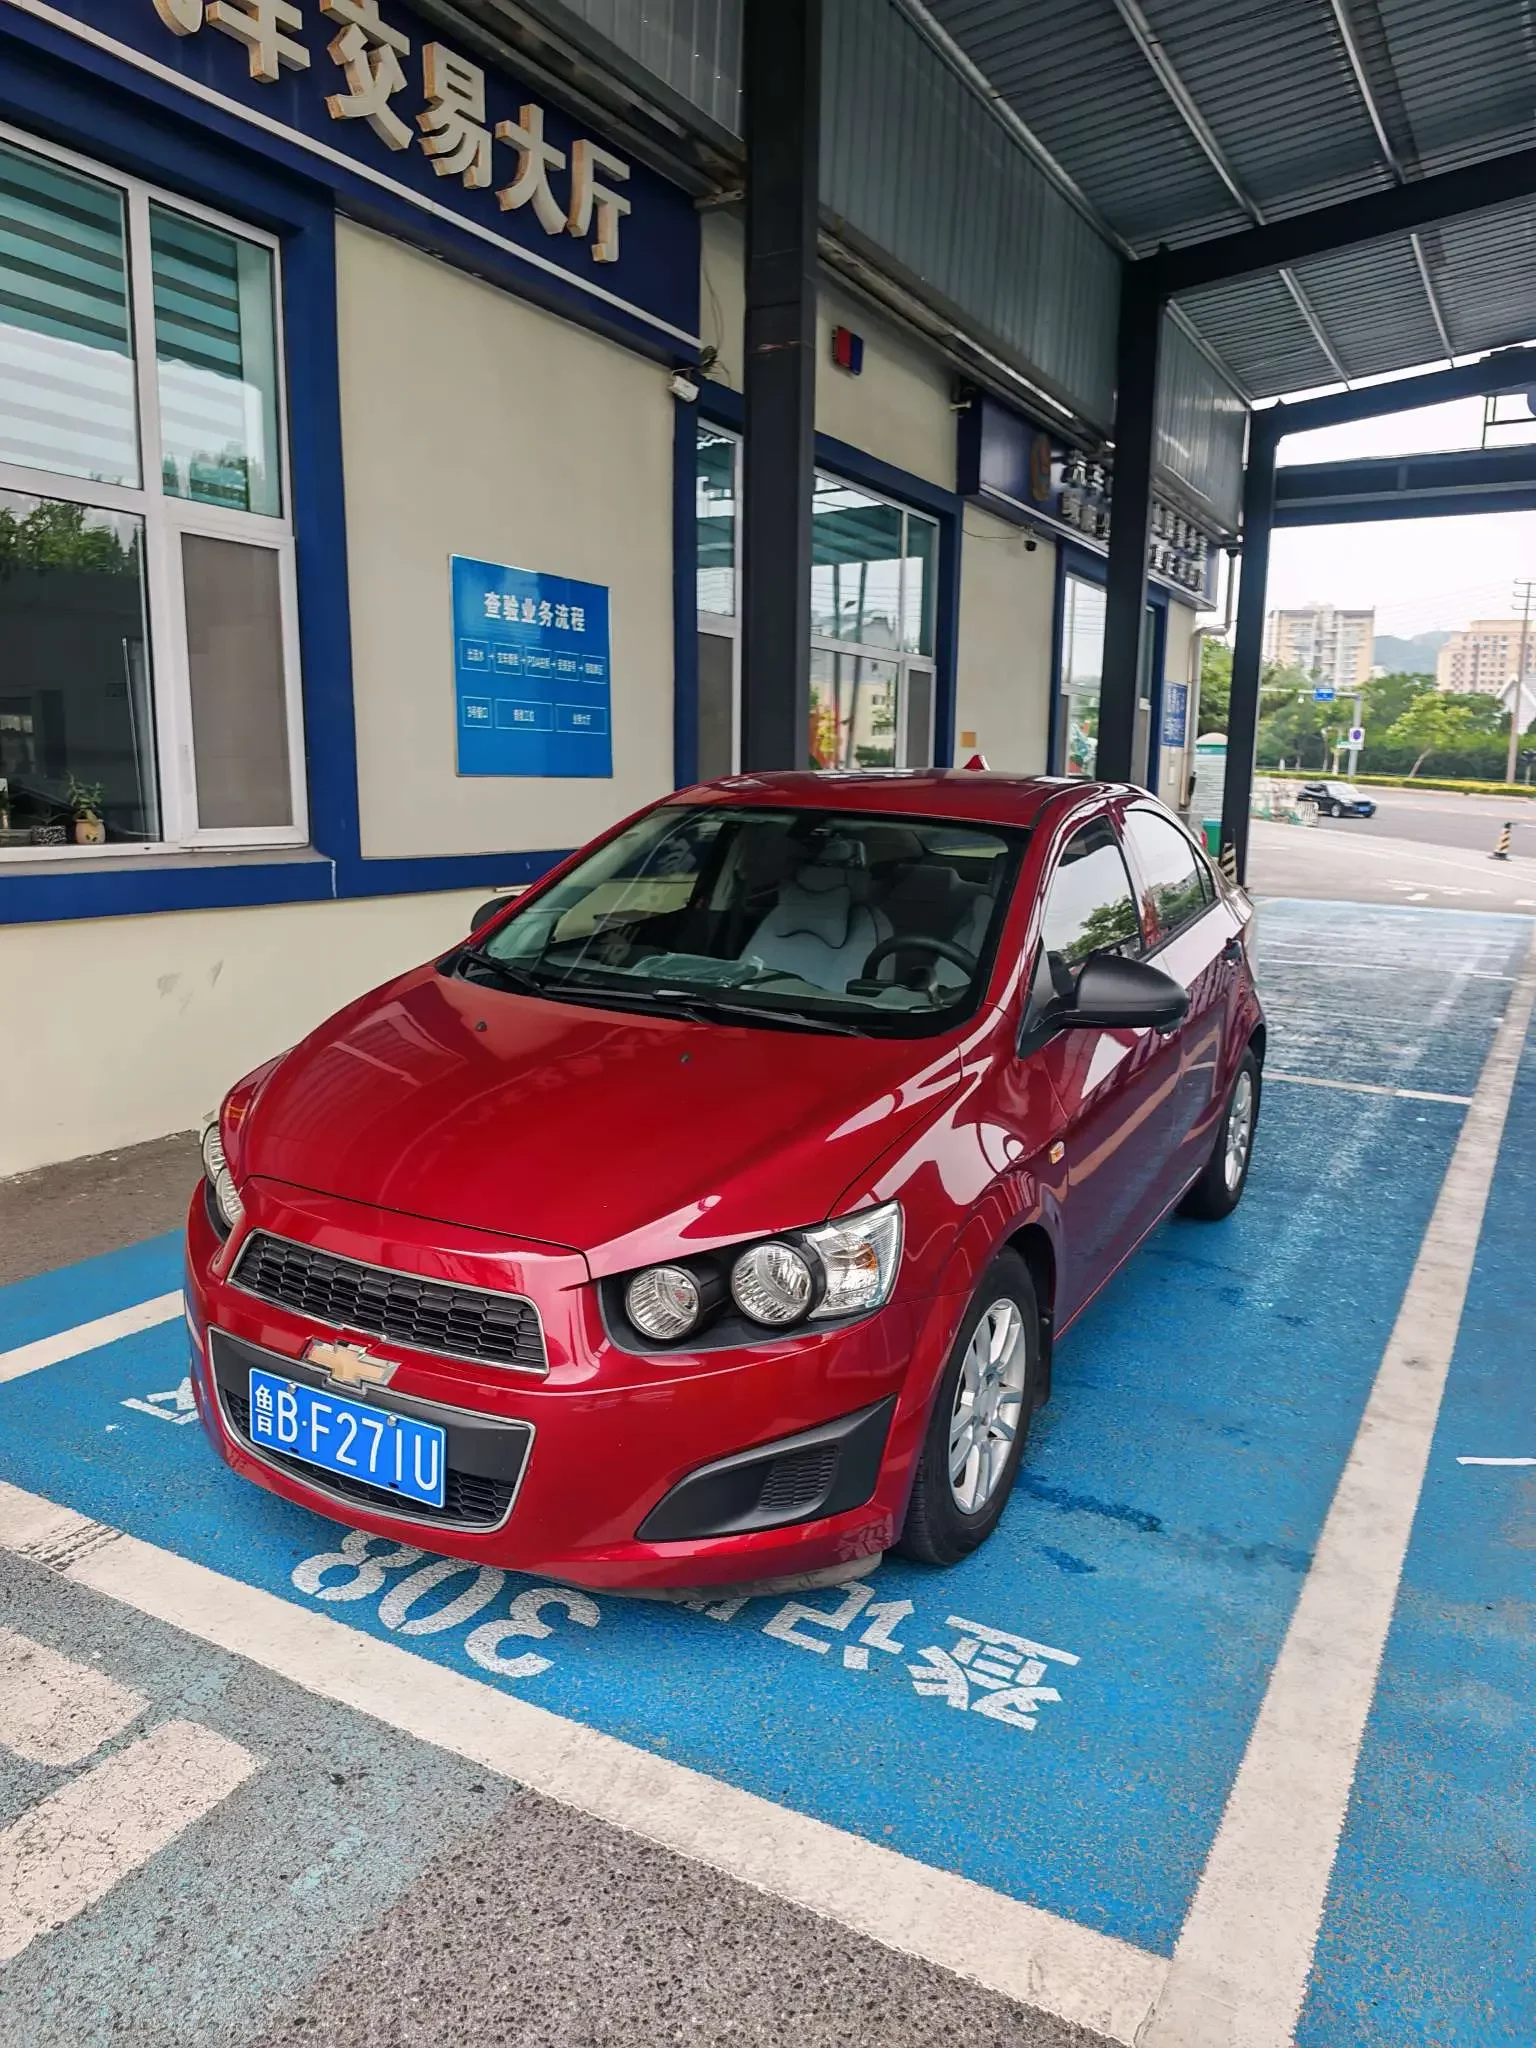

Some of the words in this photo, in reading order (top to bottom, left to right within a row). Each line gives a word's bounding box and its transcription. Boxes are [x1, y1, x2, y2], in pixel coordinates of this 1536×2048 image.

[153, 0, 632, 264] 车交易大厅
[484, 591, 587, 633] 查验业务流程
[291, 1528, 600, 1679] 308
[673, 1581, 1081, 1732] 登记
